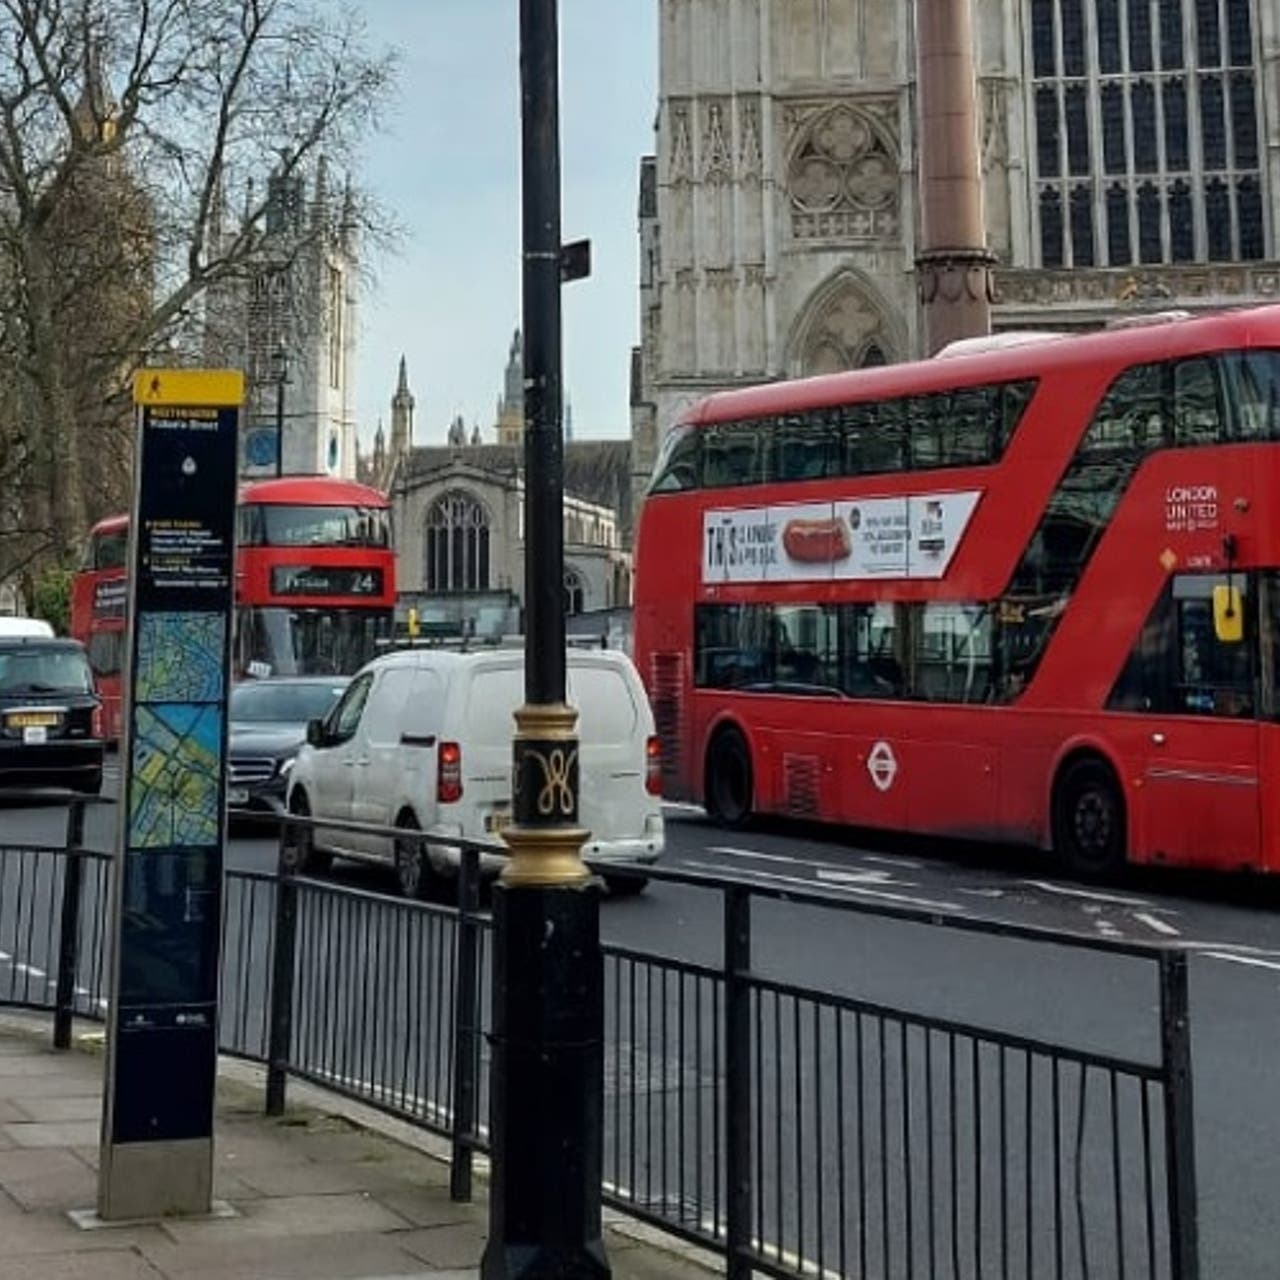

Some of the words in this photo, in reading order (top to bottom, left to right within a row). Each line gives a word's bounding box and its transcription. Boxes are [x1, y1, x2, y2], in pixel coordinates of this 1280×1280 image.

[1166, 486, 1217, 503] LONDON
[1166, 503, 1217, 519] UNITED
[351, 572, 375, 592] 24
